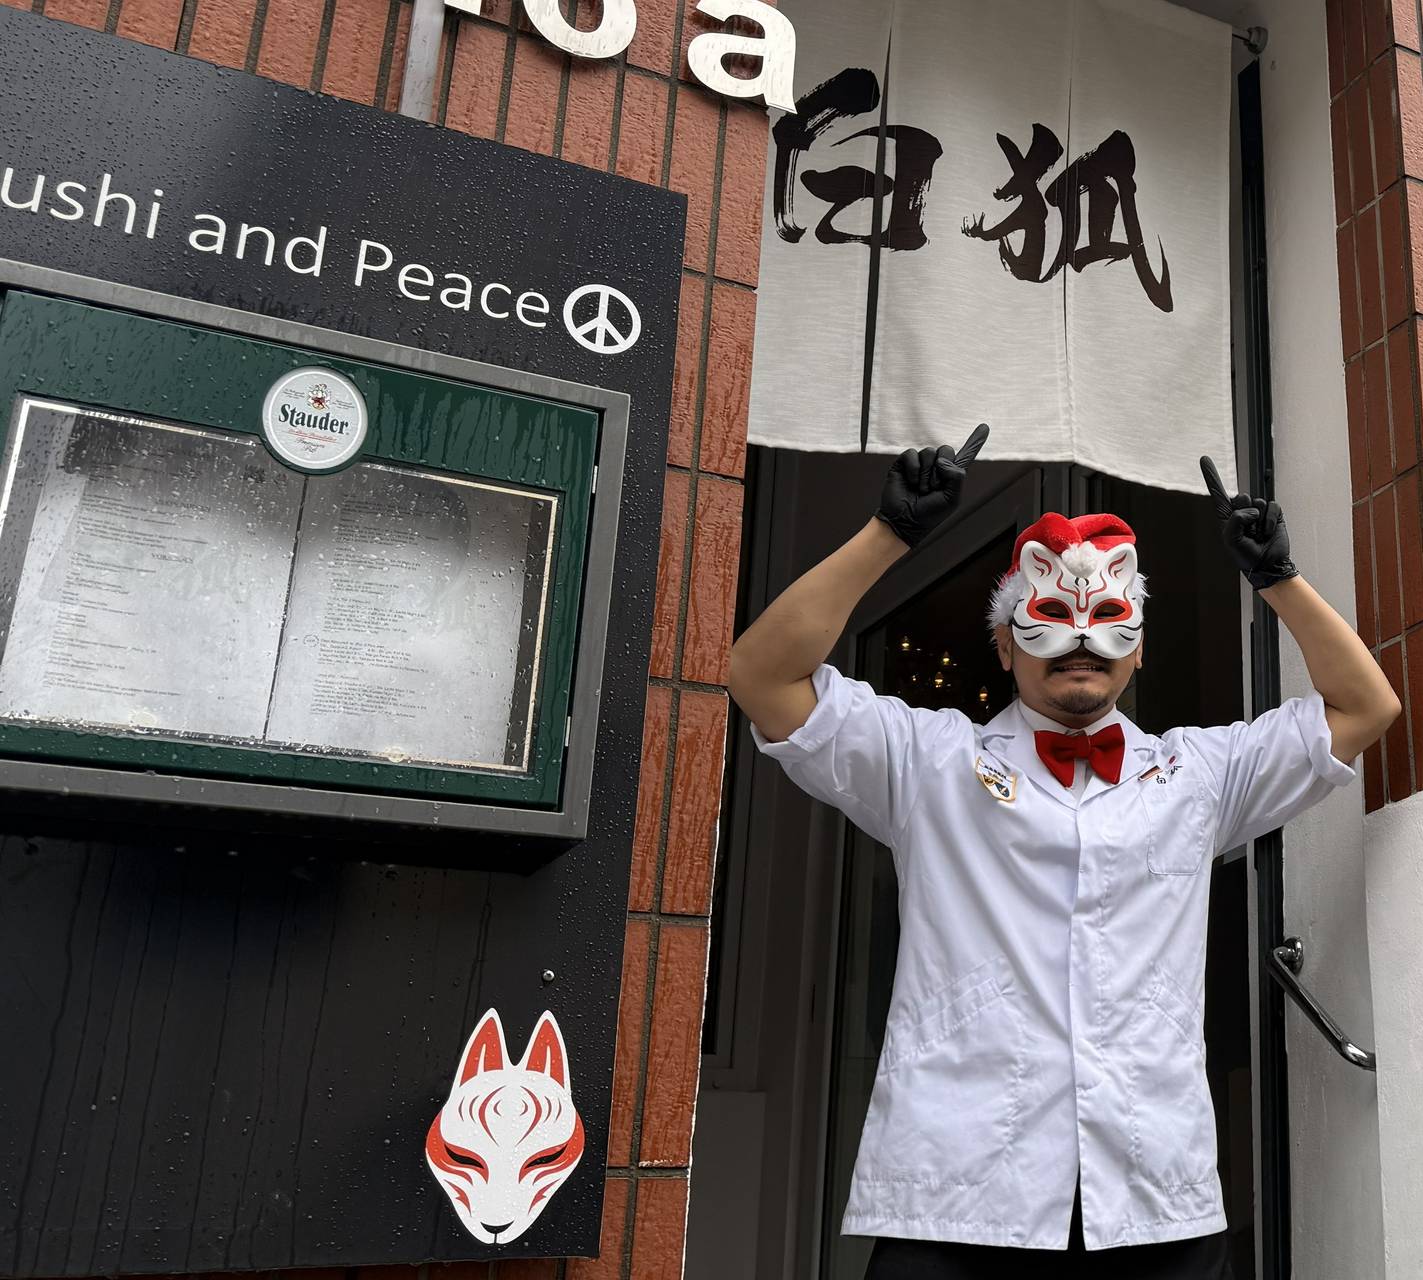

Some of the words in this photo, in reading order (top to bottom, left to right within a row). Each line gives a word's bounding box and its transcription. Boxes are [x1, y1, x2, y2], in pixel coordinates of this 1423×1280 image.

[774, 68, 1174, 312] 白狐
[188, 208, 328, 277] and
[354, 238, 551, 328] Peace
[279, 404, 348, 434] Stauder
